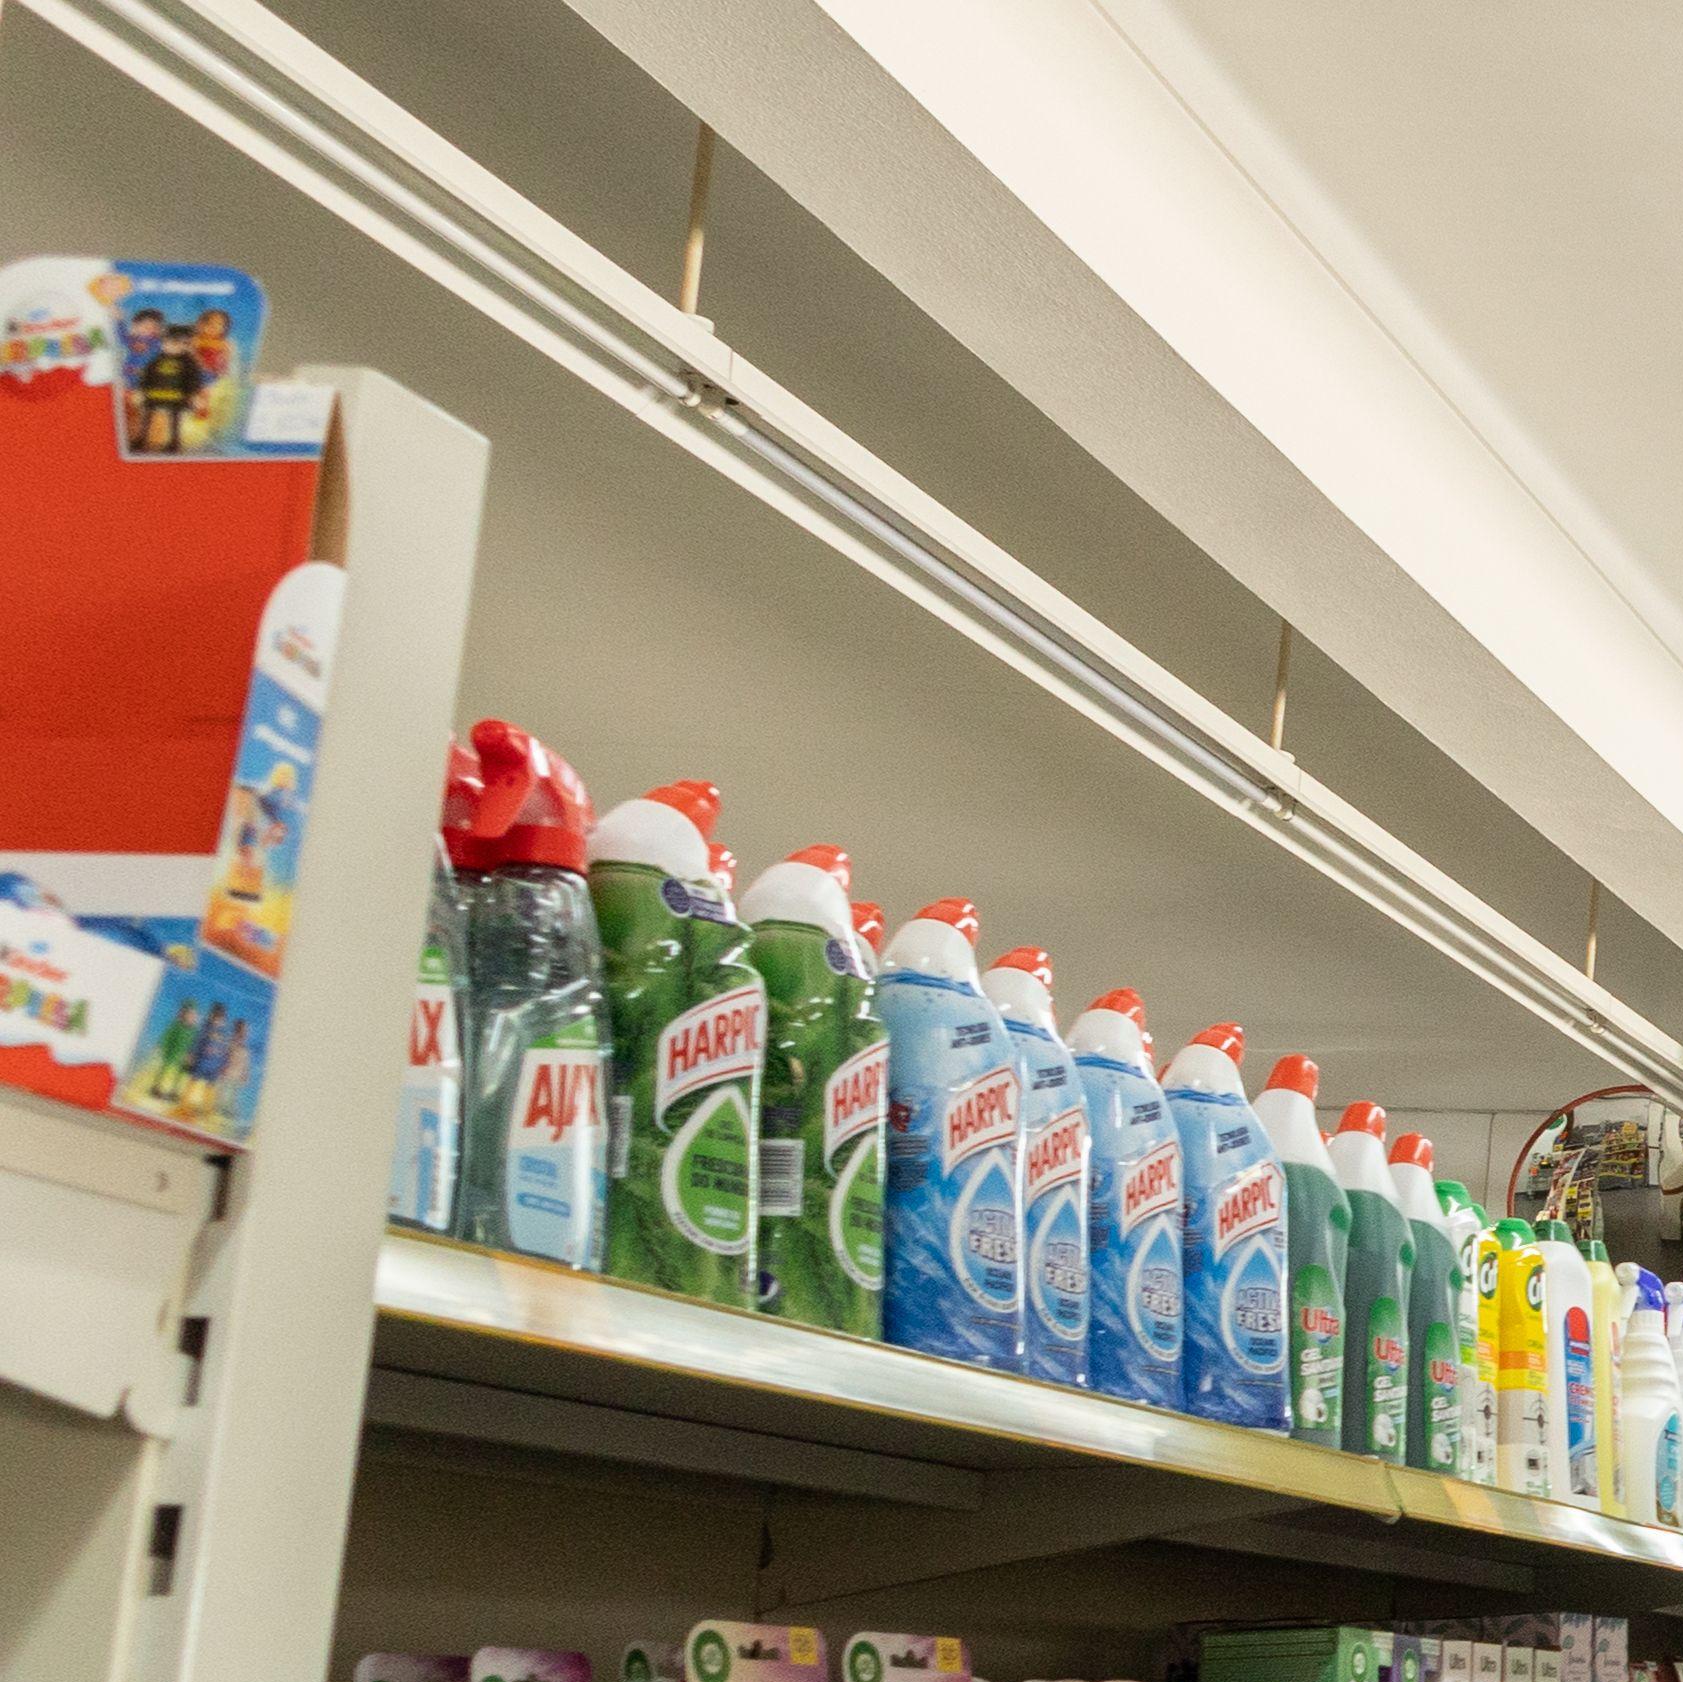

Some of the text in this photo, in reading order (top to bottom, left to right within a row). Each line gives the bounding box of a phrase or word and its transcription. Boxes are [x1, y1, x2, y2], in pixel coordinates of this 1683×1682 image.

[667, 1004, 761, 1080] HARPIC
[950, 1081, 1013, 1151] HARPIC
[1124, 1155, 1177, 1216] HARPIC
[1218, 1175, 1277, 1240] HARPIC
[1234, 1308, 1282, 1334] FRES
[1302, 1307, 1340, 1336] Ultra
